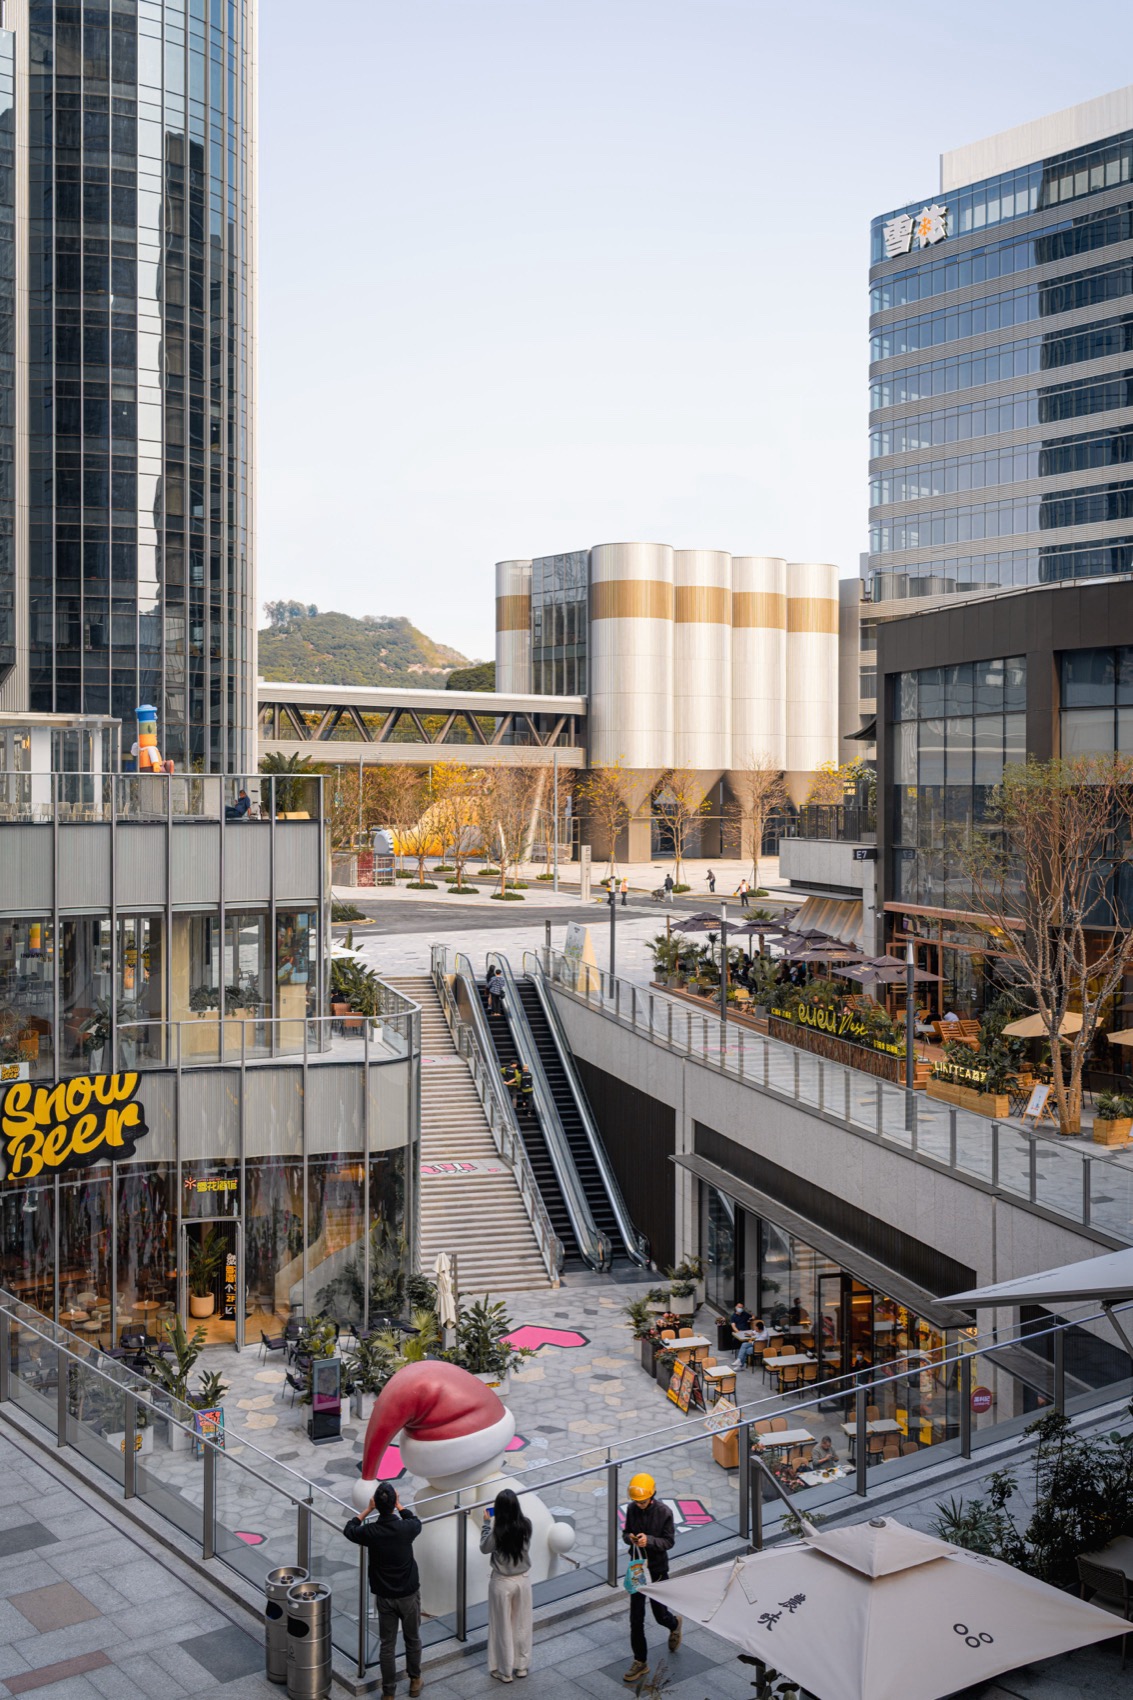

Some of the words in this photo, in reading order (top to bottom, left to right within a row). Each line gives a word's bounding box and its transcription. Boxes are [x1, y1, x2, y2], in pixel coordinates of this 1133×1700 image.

[882, 204, 948, 258] 雪花
[856, 850, 867, 859] E7
[2, 1072, 138, 1137] Snow
[7, 1102, 140, 1180] Beer
